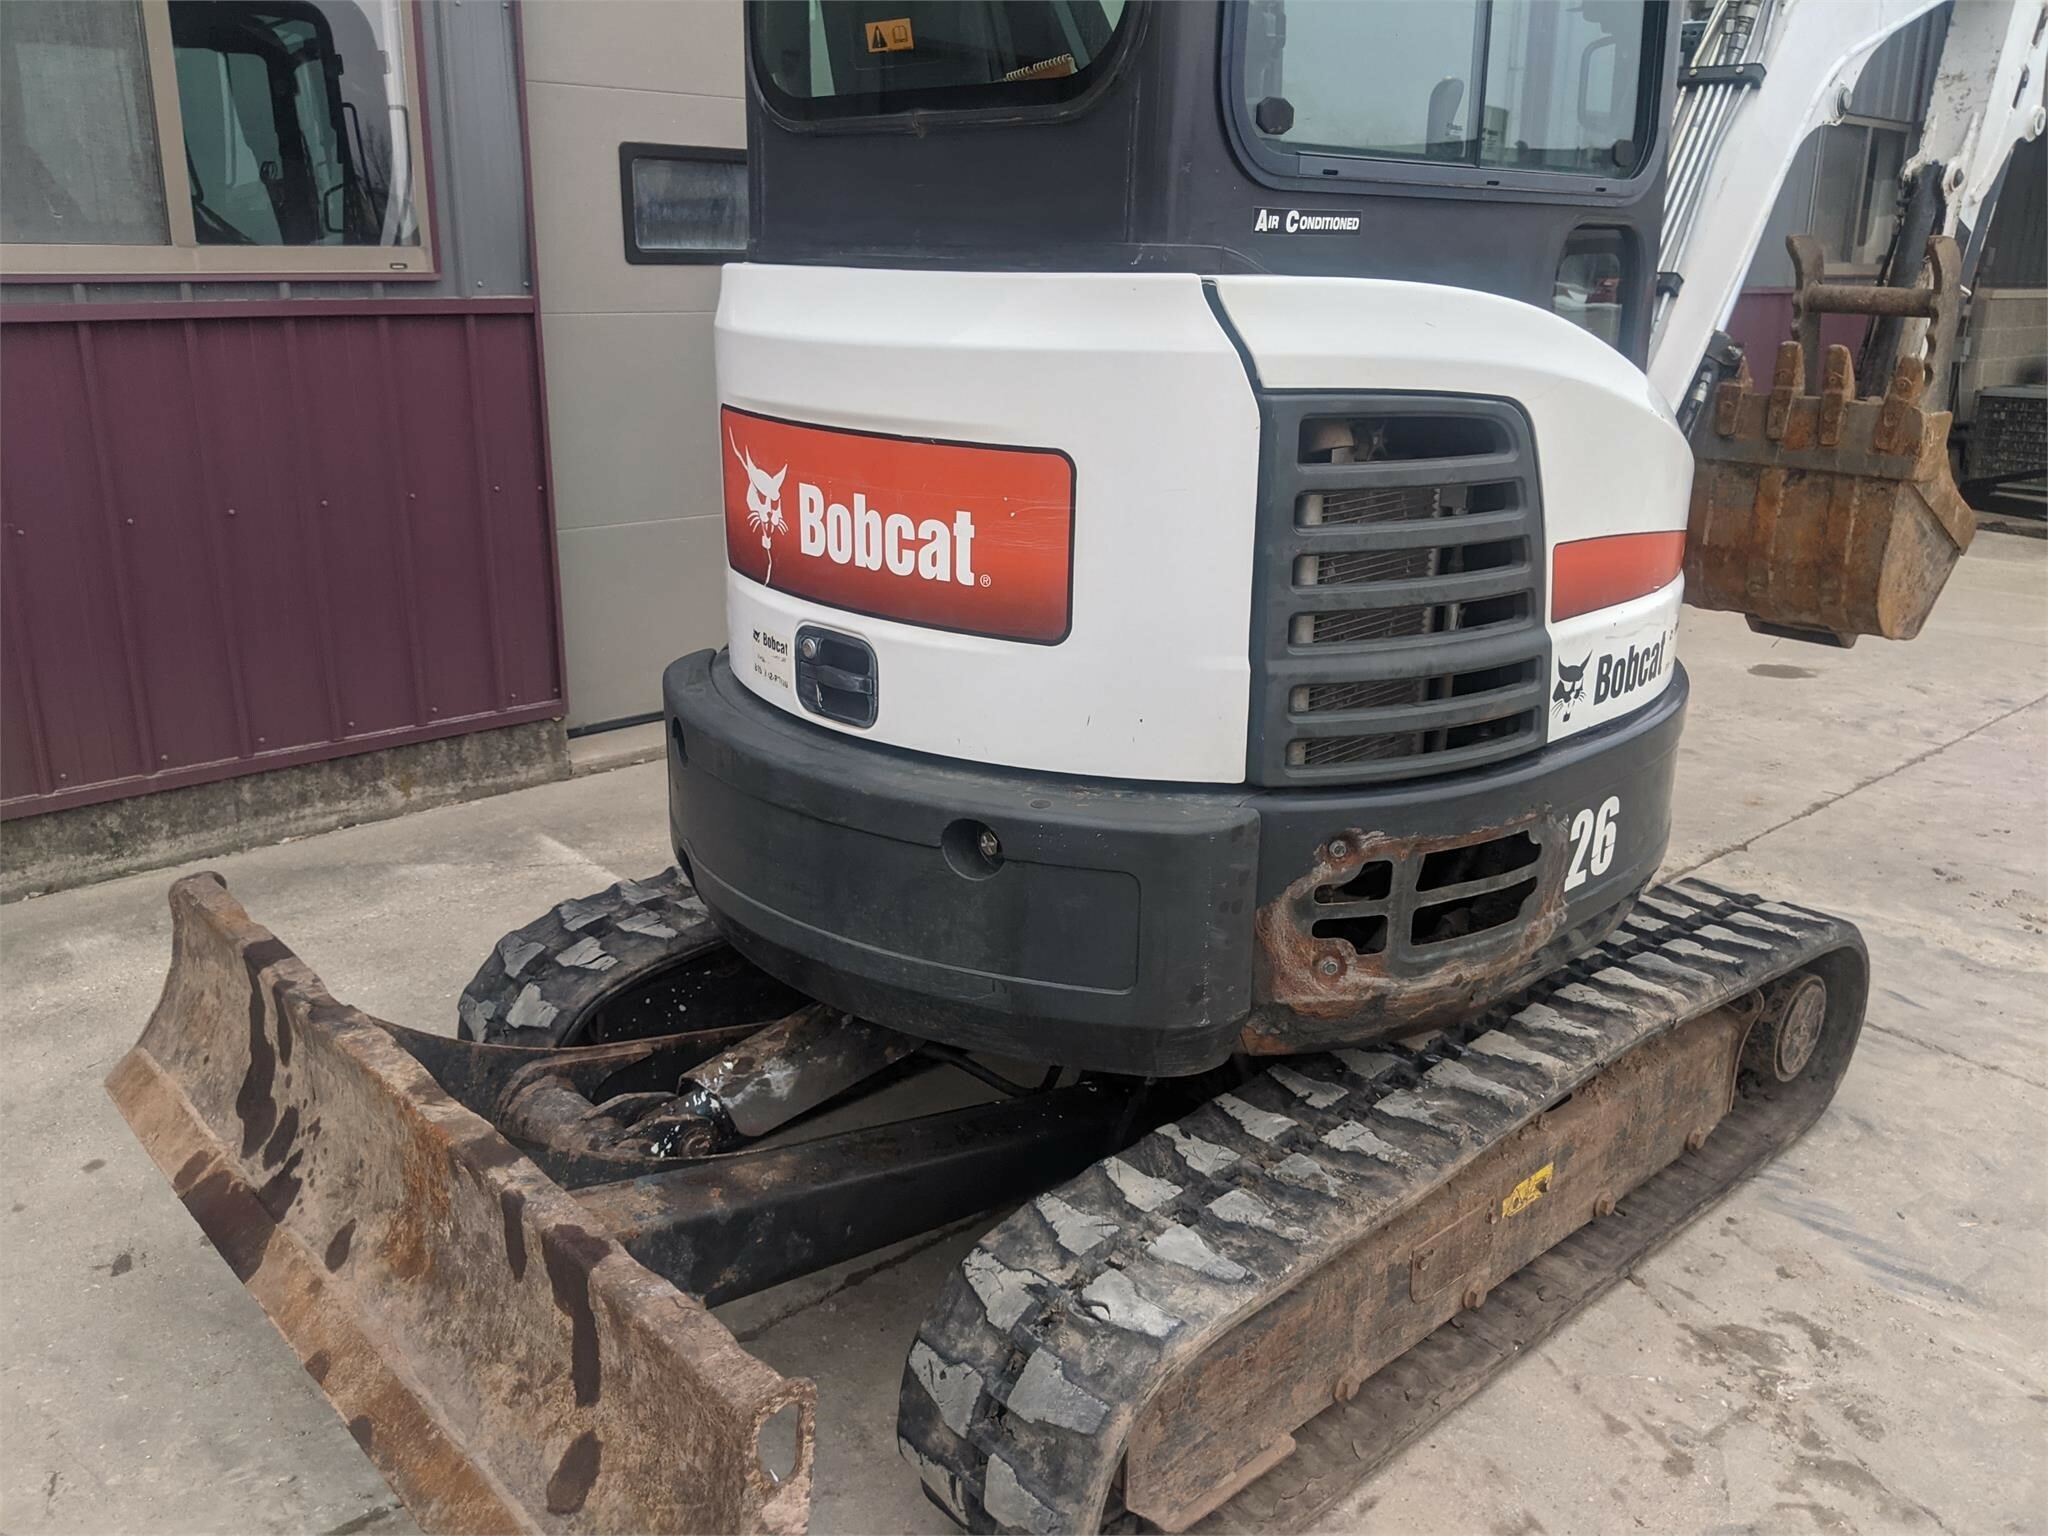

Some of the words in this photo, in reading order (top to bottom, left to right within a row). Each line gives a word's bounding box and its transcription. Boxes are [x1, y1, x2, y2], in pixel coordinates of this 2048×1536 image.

[798, 482, 975, 586] Bobcat
[762, 632, 788, 656] Bobcat
[1593, 630, 1667, 706] Bobcat
